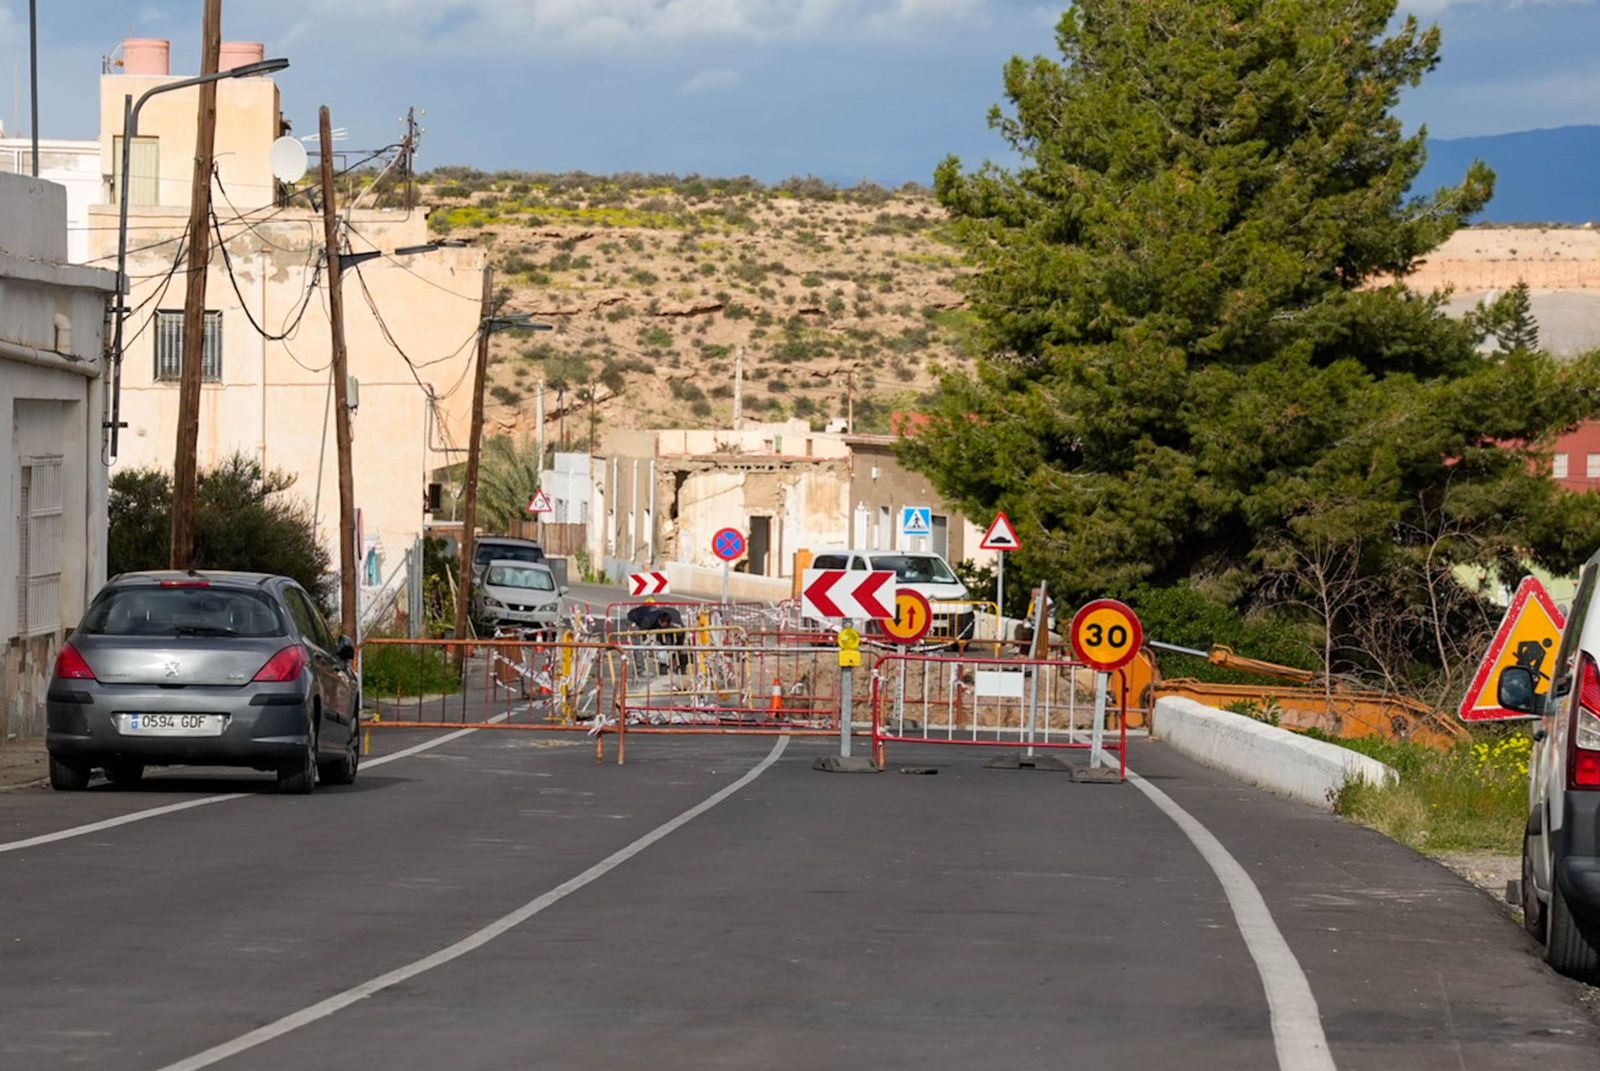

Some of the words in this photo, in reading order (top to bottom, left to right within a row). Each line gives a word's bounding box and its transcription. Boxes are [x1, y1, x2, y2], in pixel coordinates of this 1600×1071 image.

[1085, 624, 1127, 648] 30
[142, 715, 174, 728] 0594
[181, 715, 206, 728] GDF
